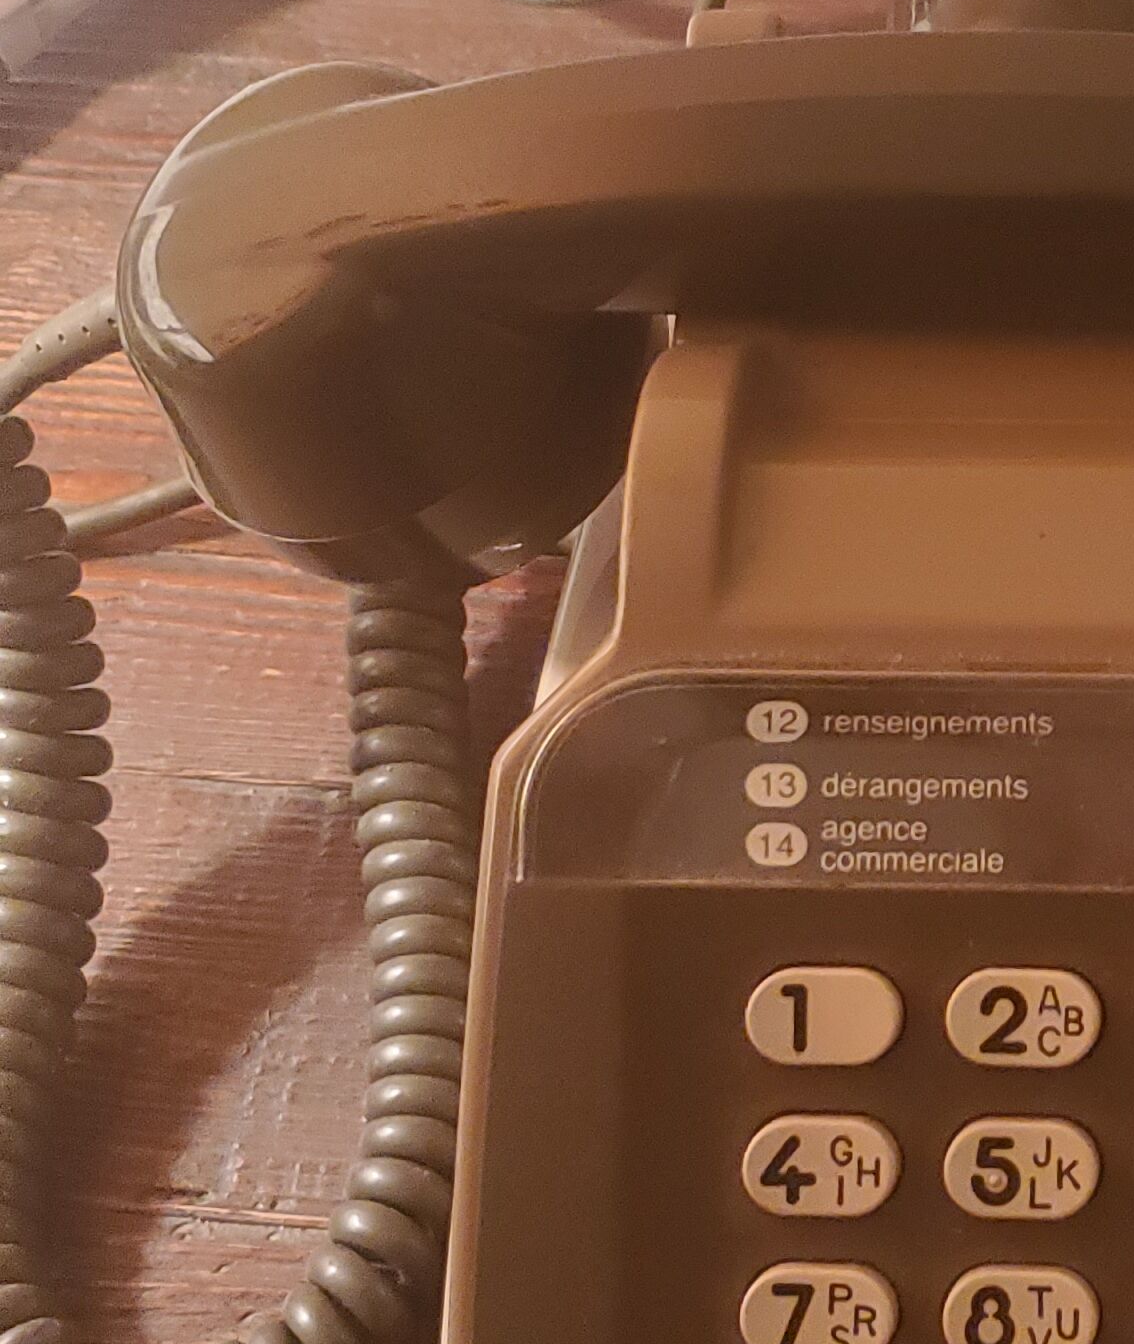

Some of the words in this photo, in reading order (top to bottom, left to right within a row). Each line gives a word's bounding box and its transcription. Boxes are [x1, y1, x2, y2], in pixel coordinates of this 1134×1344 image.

[762, 710, 798, 733] 12
[824, 713, 1054, 740] renseignements
[762, 772, 797, 798] 13
[821, 771, 1029, 805] dérangements
[760, 833, 793, 857] 14
[821, 818, 927, 842] agence
[820, 849, 1004, 873] commerciale
[781, 984, 808, 1052] 1
[979, 985, 1028, 1054] 2
[760, 1135, 816, 1205] 4
[970, 1137, 1021, 1206] 5
